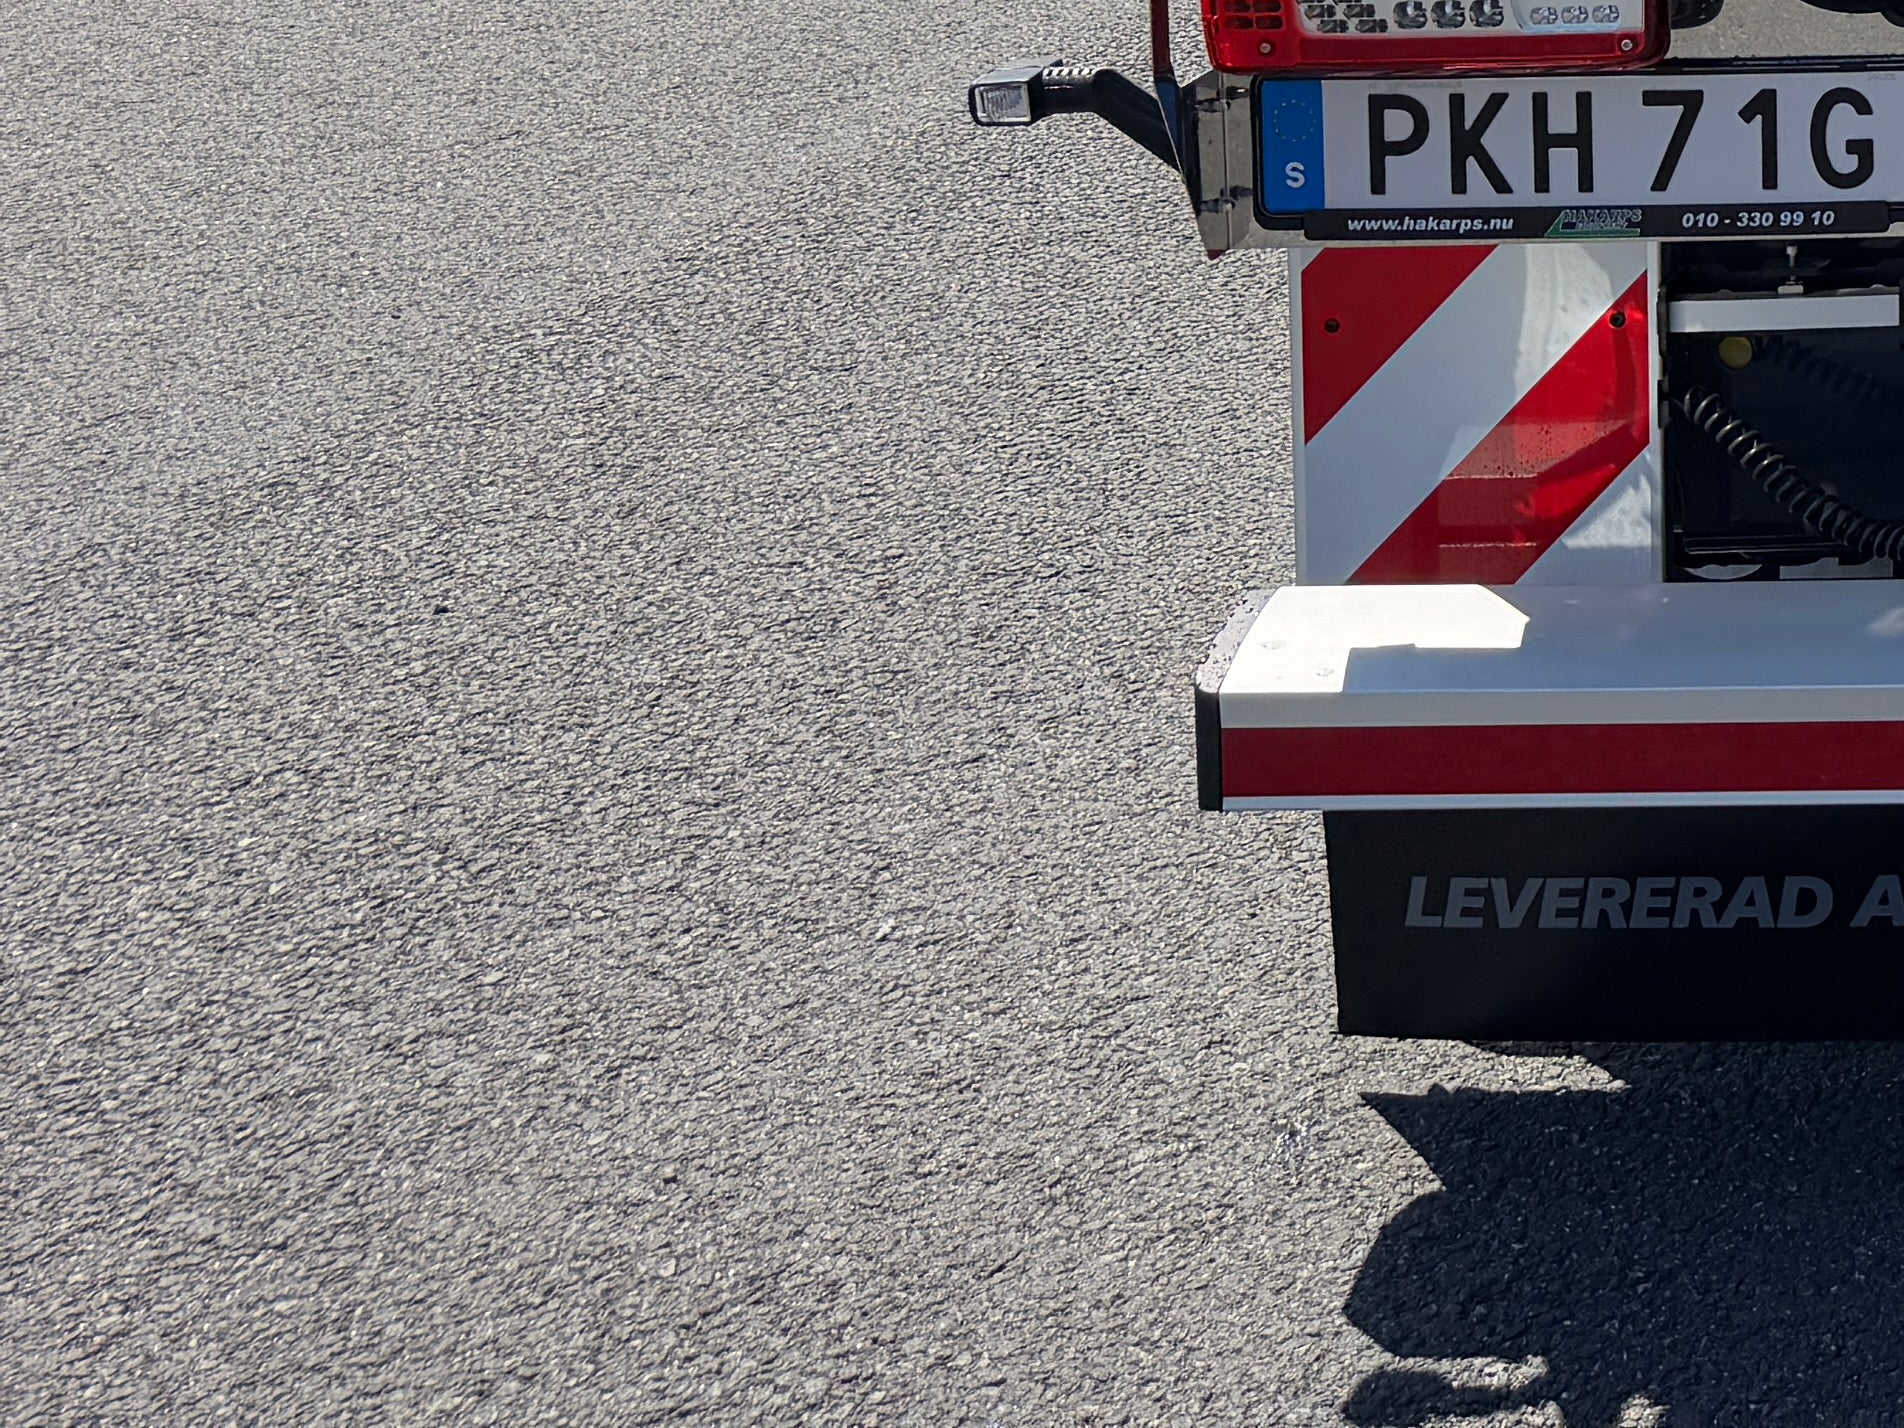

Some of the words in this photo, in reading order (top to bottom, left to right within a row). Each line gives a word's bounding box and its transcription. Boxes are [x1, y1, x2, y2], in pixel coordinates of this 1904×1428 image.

[1366, 89, 1595, 197] PKH
[1640, 85, 1876, 194] 71G
[1284, 161, 1306, 188] S
[1347, 215, 1515, 234] www.hakarps.nu
[1681, 212, 1719, 228] 010
[1736, 211, 1774, 227] 330
[1779, 210, 1804, 226] 99
[1811, 210, 1835, 226] 10
[1403, 874, 1833, 930] LEVERERAD
